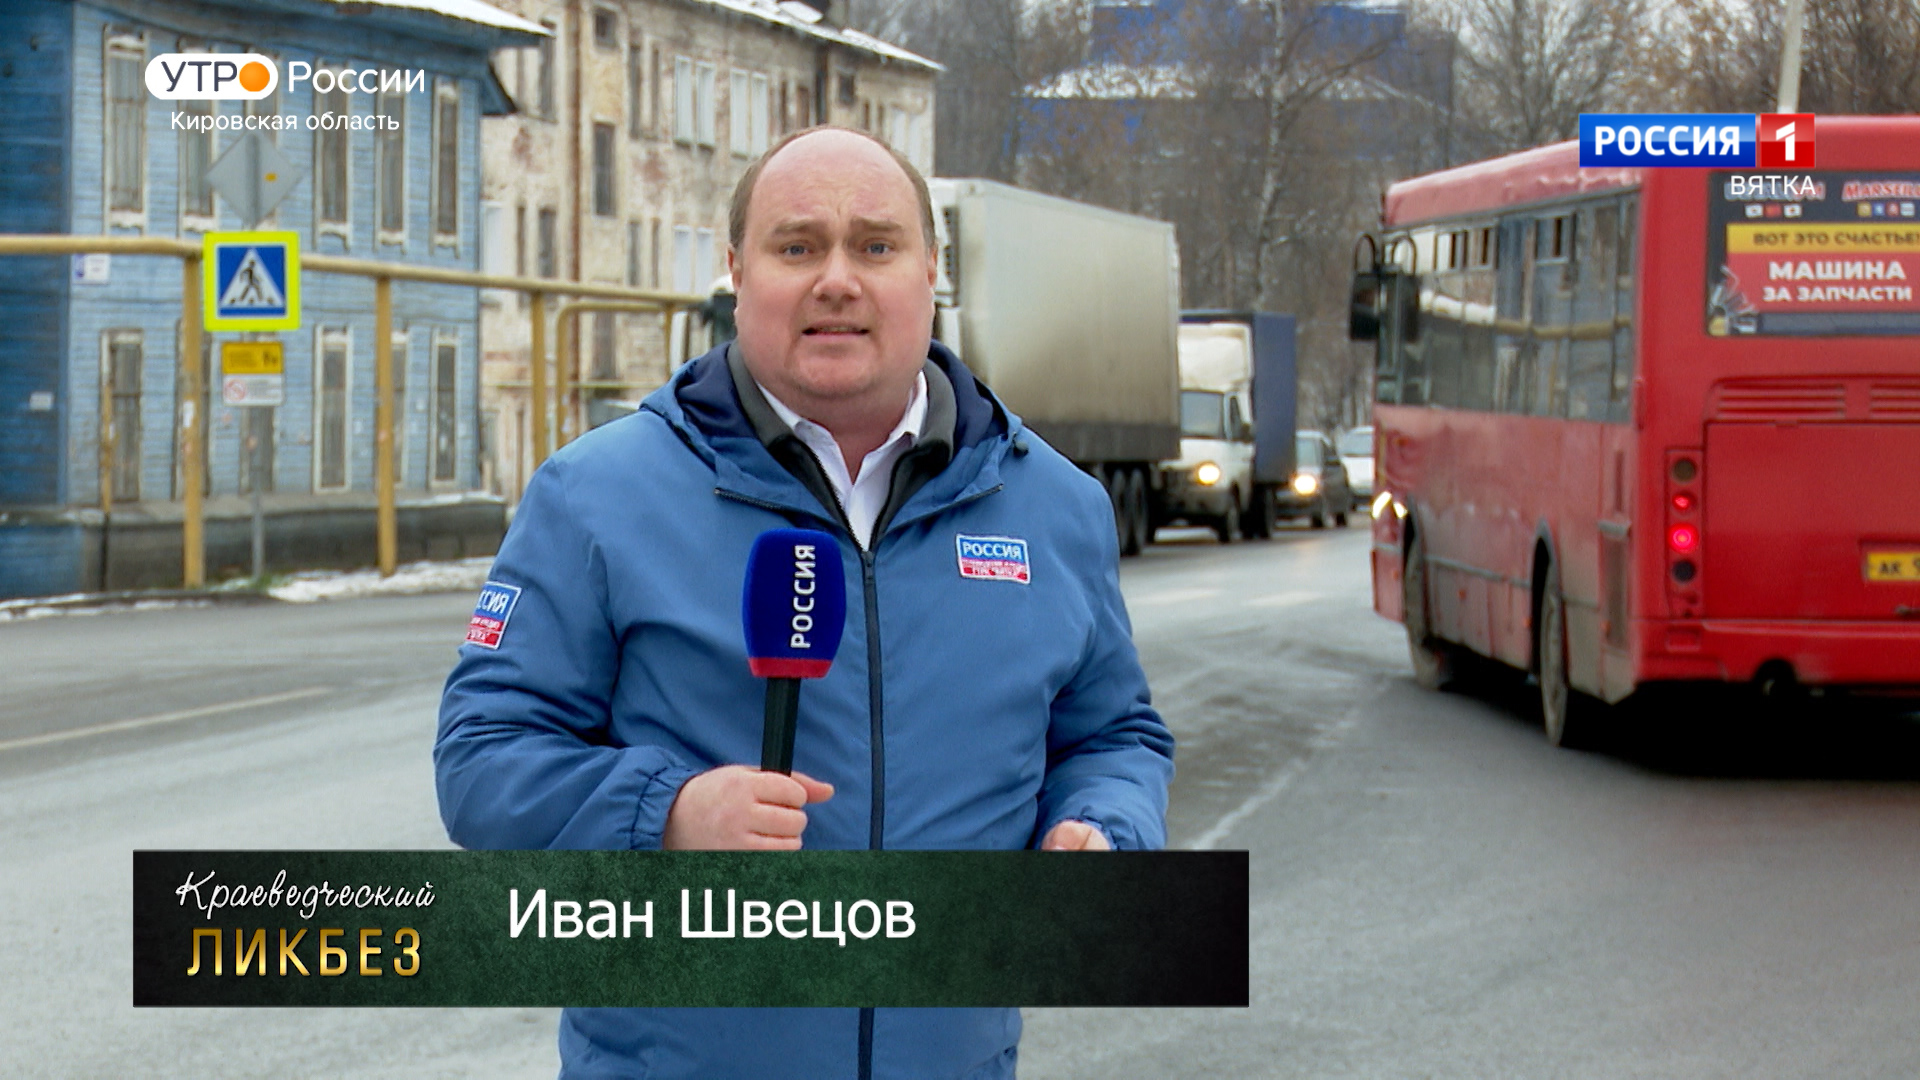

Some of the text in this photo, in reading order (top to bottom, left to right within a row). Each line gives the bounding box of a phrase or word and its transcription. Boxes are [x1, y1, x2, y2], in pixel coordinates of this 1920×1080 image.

[1753, 232, 1788, 245] ВОТ
[1795, 231, 1830, 245] ЭТО
[1768, 260, 1907, 280] МАШИНА
[1762, 286, 1913, 301] ЗА ЗАПЧАСТИ
[961, 541, 1022, 560] РОССИЯ
[790, 544, 816, 649] РОССИЯ
